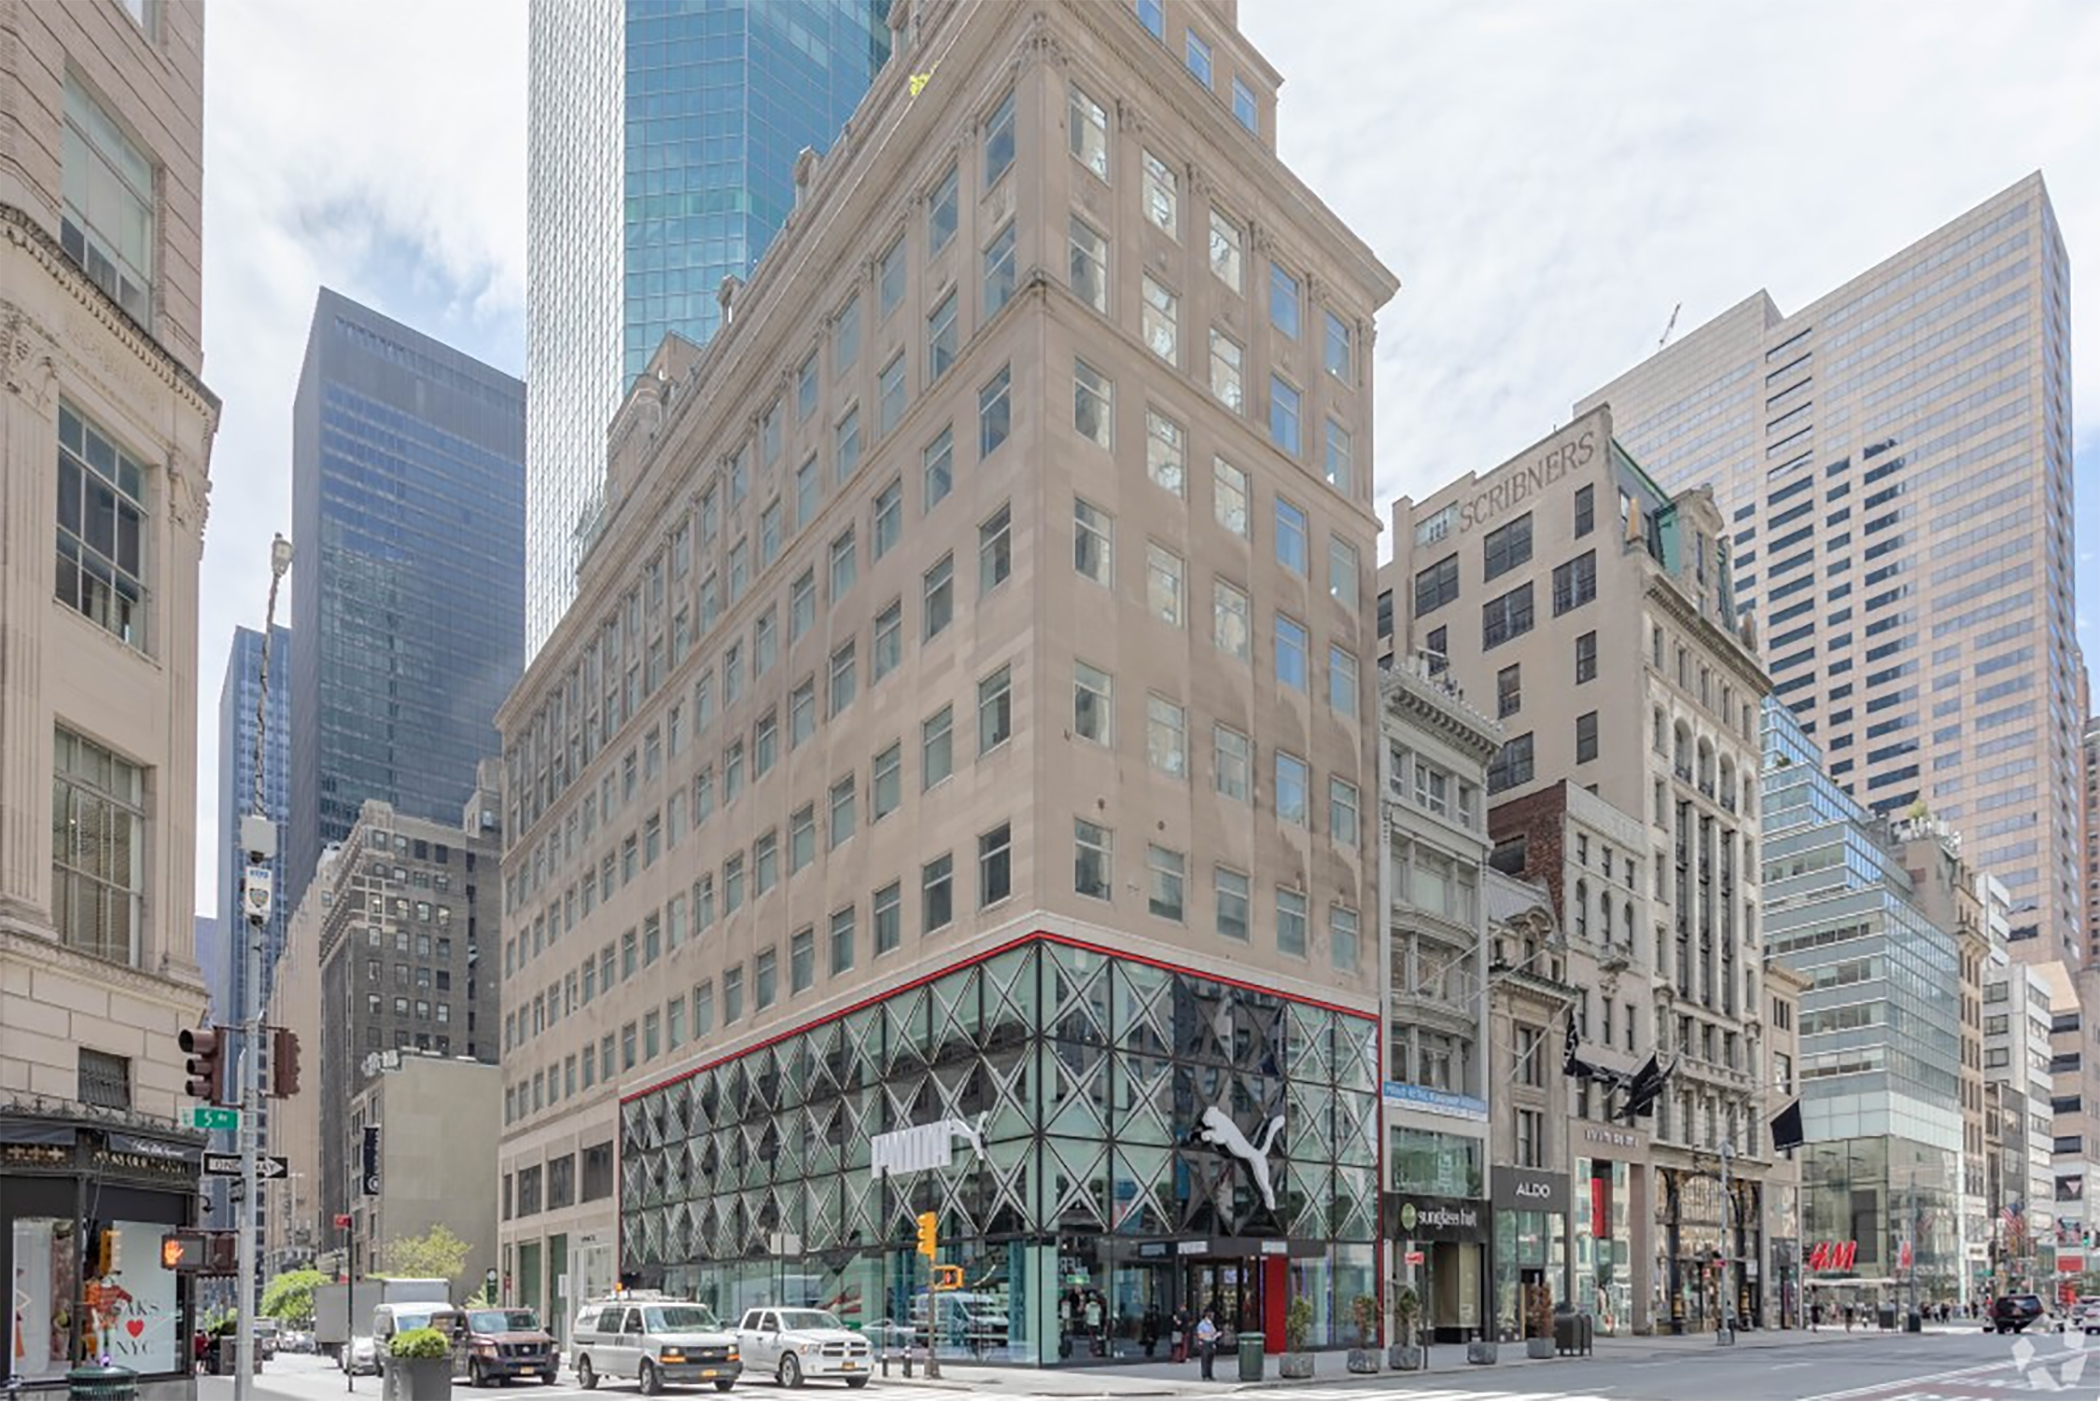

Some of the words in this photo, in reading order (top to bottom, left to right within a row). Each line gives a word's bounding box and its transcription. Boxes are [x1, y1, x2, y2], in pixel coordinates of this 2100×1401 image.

[1460, 431, 1595, 533] SCRIBNERS
[204, 1111, 213, 1127] 5
[1516, 1182, 1550, 1197] ALDO
[1418, 1206, 1459, 1229] sunglass
[115, 1341, 154, 1356] NYC
